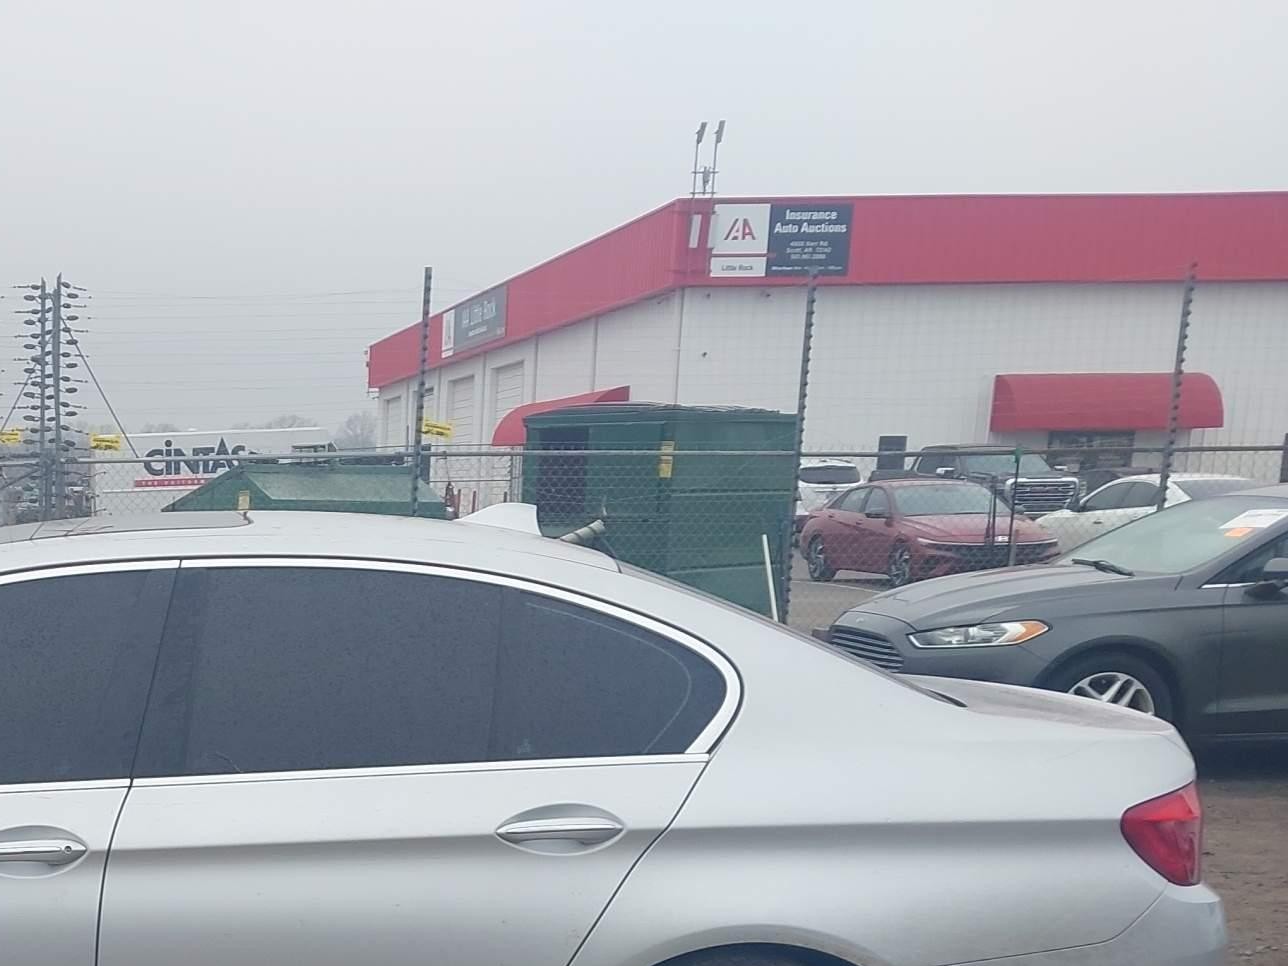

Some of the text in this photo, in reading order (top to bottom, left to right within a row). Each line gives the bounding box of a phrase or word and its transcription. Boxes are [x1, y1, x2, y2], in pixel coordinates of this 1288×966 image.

[785, 209, 838, 220] Insurance
[774, 222, 847, 234] Auto Auctions
